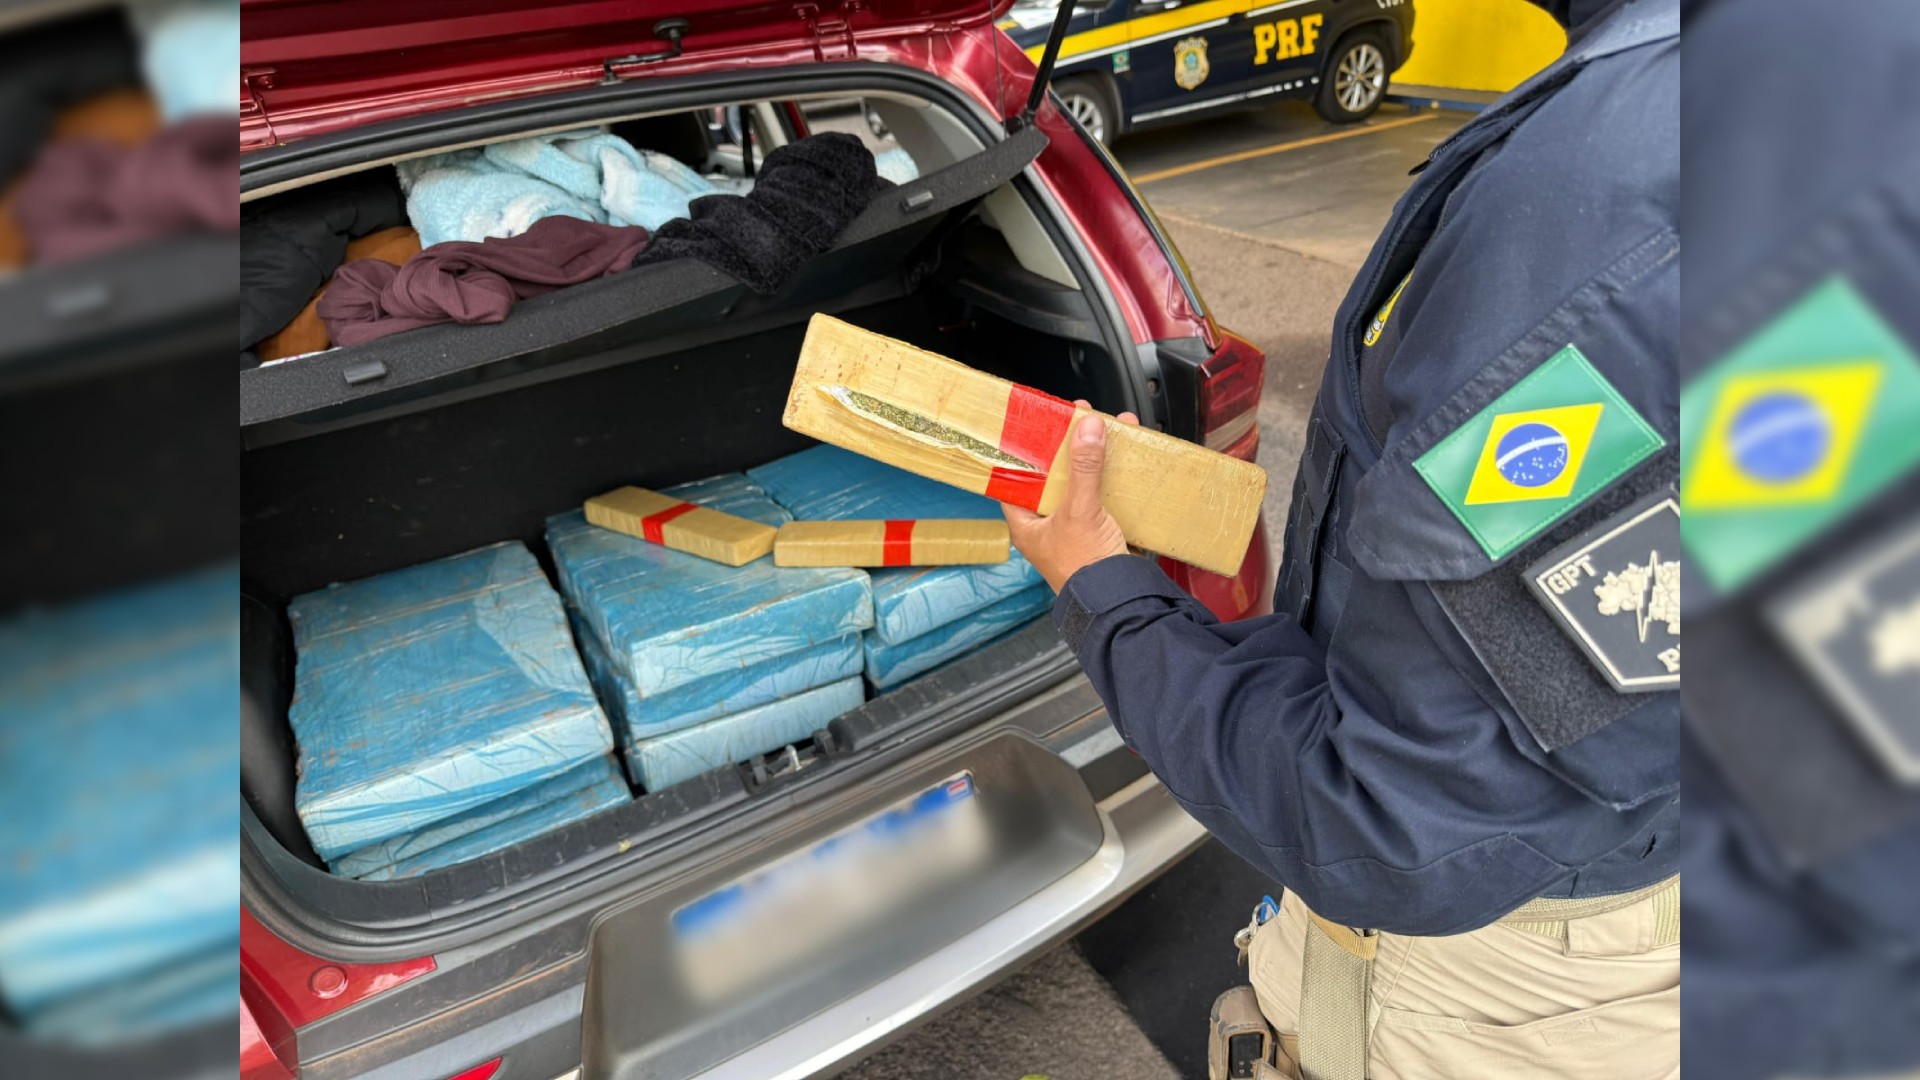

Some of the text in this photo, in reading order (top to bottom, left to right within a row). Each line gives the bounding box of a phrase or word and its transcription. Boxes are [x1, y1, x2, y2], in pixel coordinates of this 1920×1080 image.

[1253, 12, 1323, 65] PRF
[1547, 553, 1596, 595] GPT
[1657, 643, 1680, 673] P
